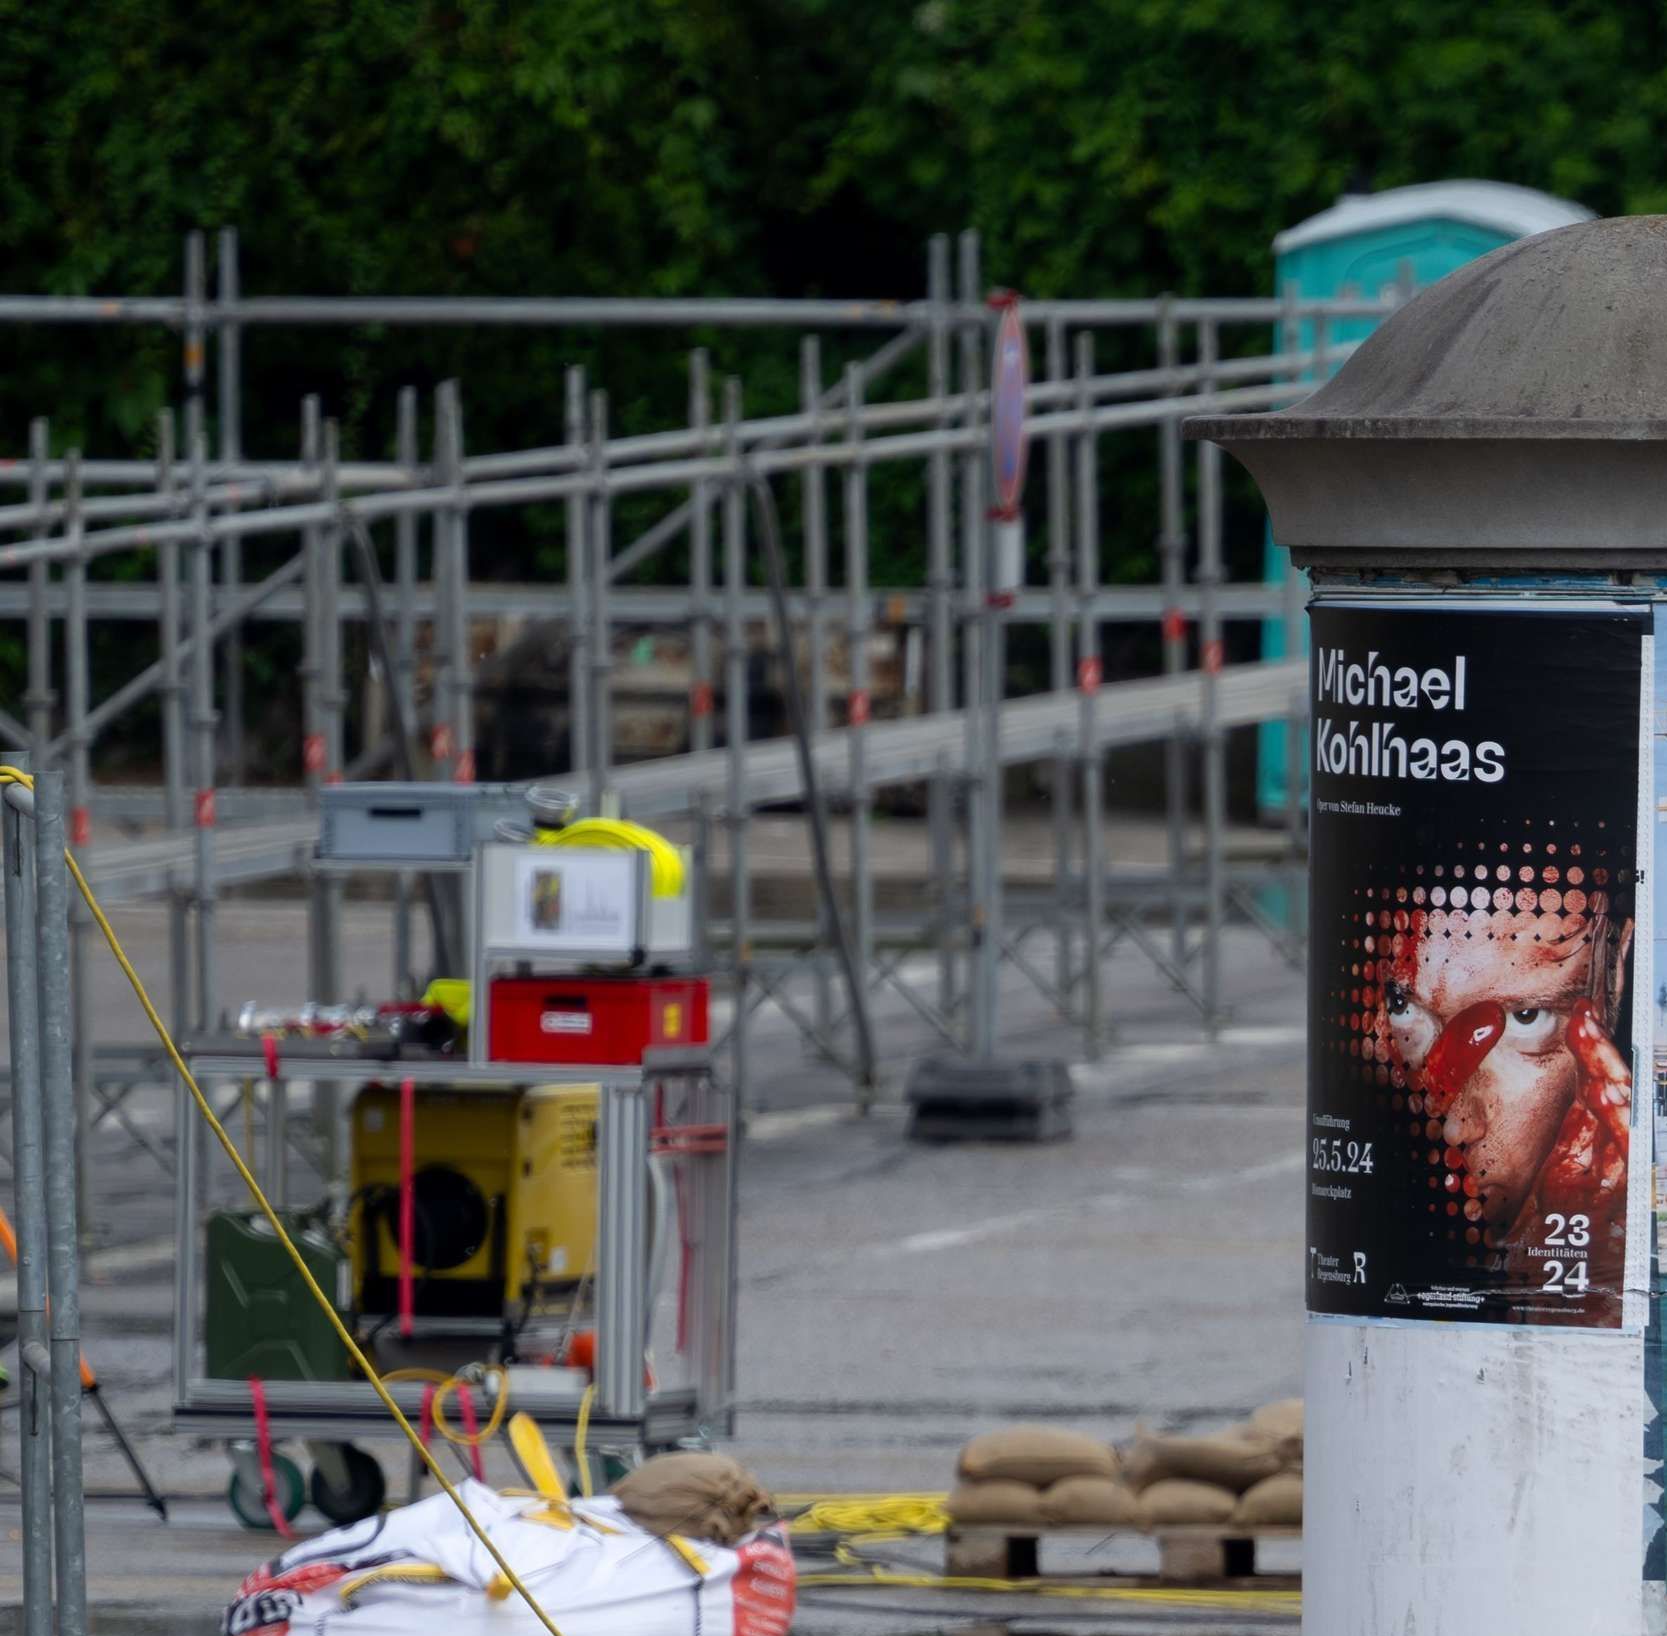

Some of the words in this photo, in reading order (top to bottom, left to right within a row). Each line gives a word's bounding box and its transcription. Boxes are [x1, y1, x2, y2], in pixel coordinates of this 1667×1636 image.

[1318, 648, 1466, 710] Michael
[1316, 718, 1505, 783] Kohlhaas
[1340, 800, 1365, 814] Stefan
[1366, 802, 1401, 816] Heucke
[1313, 1138, 1374, 1174] 25.5.24
[1544, 1213, 1590, 1247] 23
[1317, 1253, 1339, 1267] Theater
[1353, 1251, 1367, 1284] R
[1527, 1246, 1588, 1259] Identitäten
[1317, 1268, 1351, 1285] Regensburg
[1542, 1261, 1590, 1297] 24
